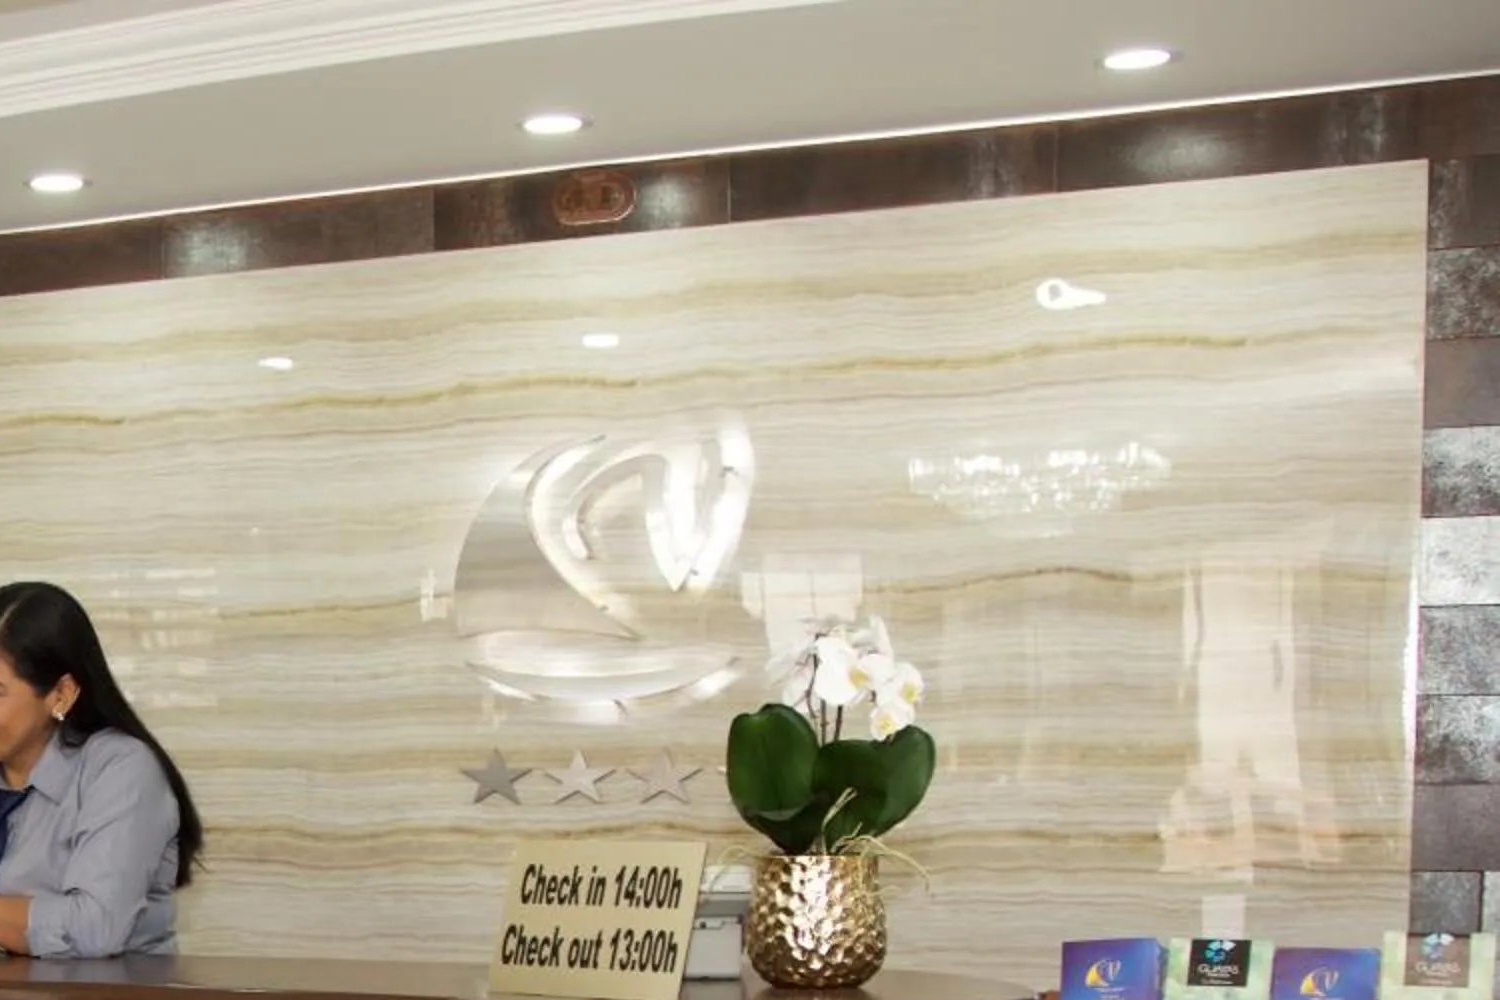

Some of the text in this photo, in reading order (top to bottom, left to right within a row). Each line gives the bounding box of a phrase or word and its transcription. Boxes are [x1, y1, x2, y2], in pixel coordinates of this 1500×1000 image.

[520, 863, 683, 909] Check in 14:00h
[501, 924, 679, 973] Check out 13:00h
